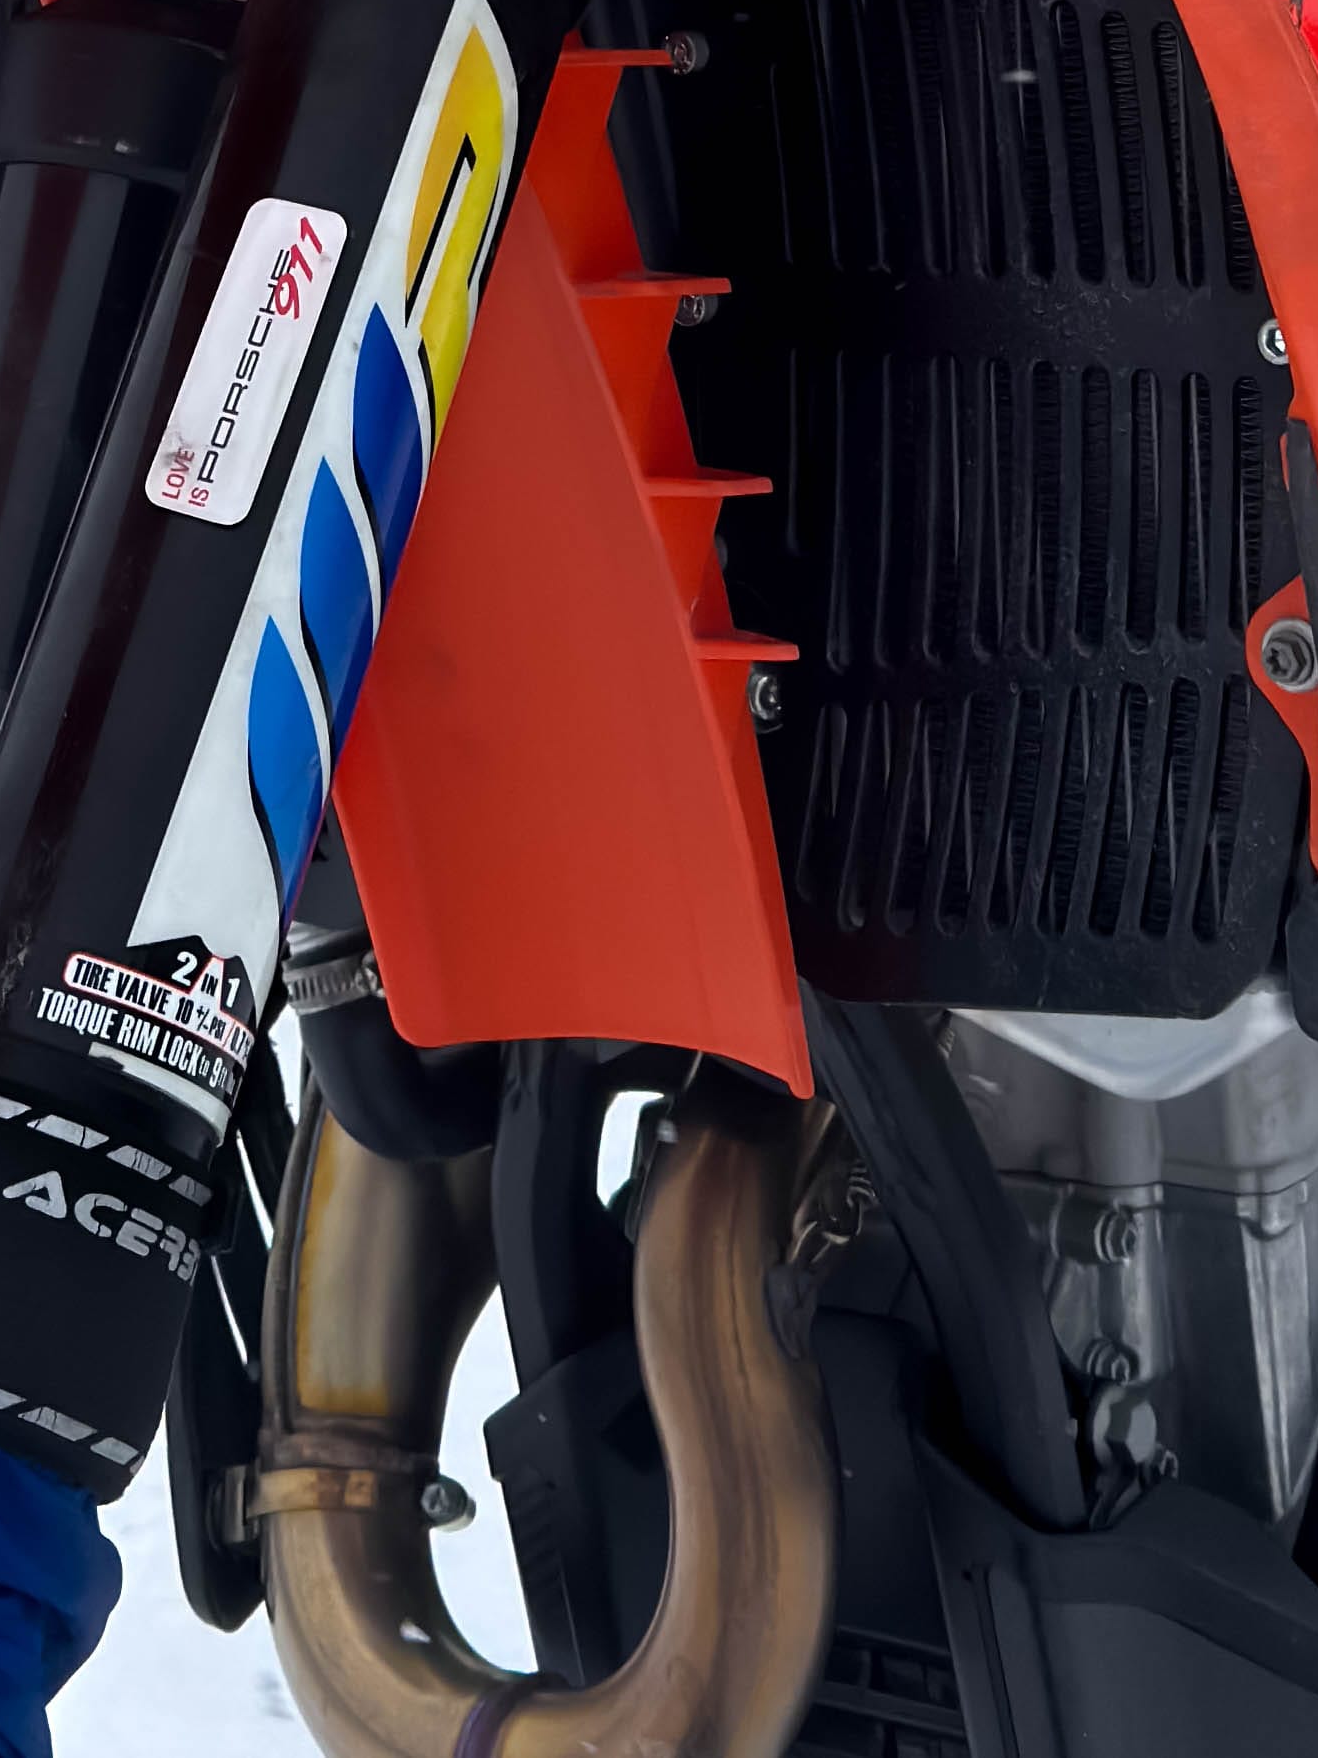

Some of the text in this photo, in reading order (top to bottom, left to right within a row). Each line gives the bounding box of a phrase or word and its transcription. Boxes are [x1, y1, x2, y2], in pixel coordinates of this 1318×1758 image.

[274, 216, 323, 320] 911
[188, 248, 291, 508] IS PORSCHE
[161, 447, 195, 500] LOVE
[72, 957, 115, 992] TIRE
[114, 972, 172, 1015] VALVE
[175, 996, 195, 1025] 10
[171, 951, 241, 1008] 2 IN 1
[36, 987, 118, 1040] TORQUE
[117, 1014, 160, 1057] RIM
[157, 1030, 204, 1077] LOCK
